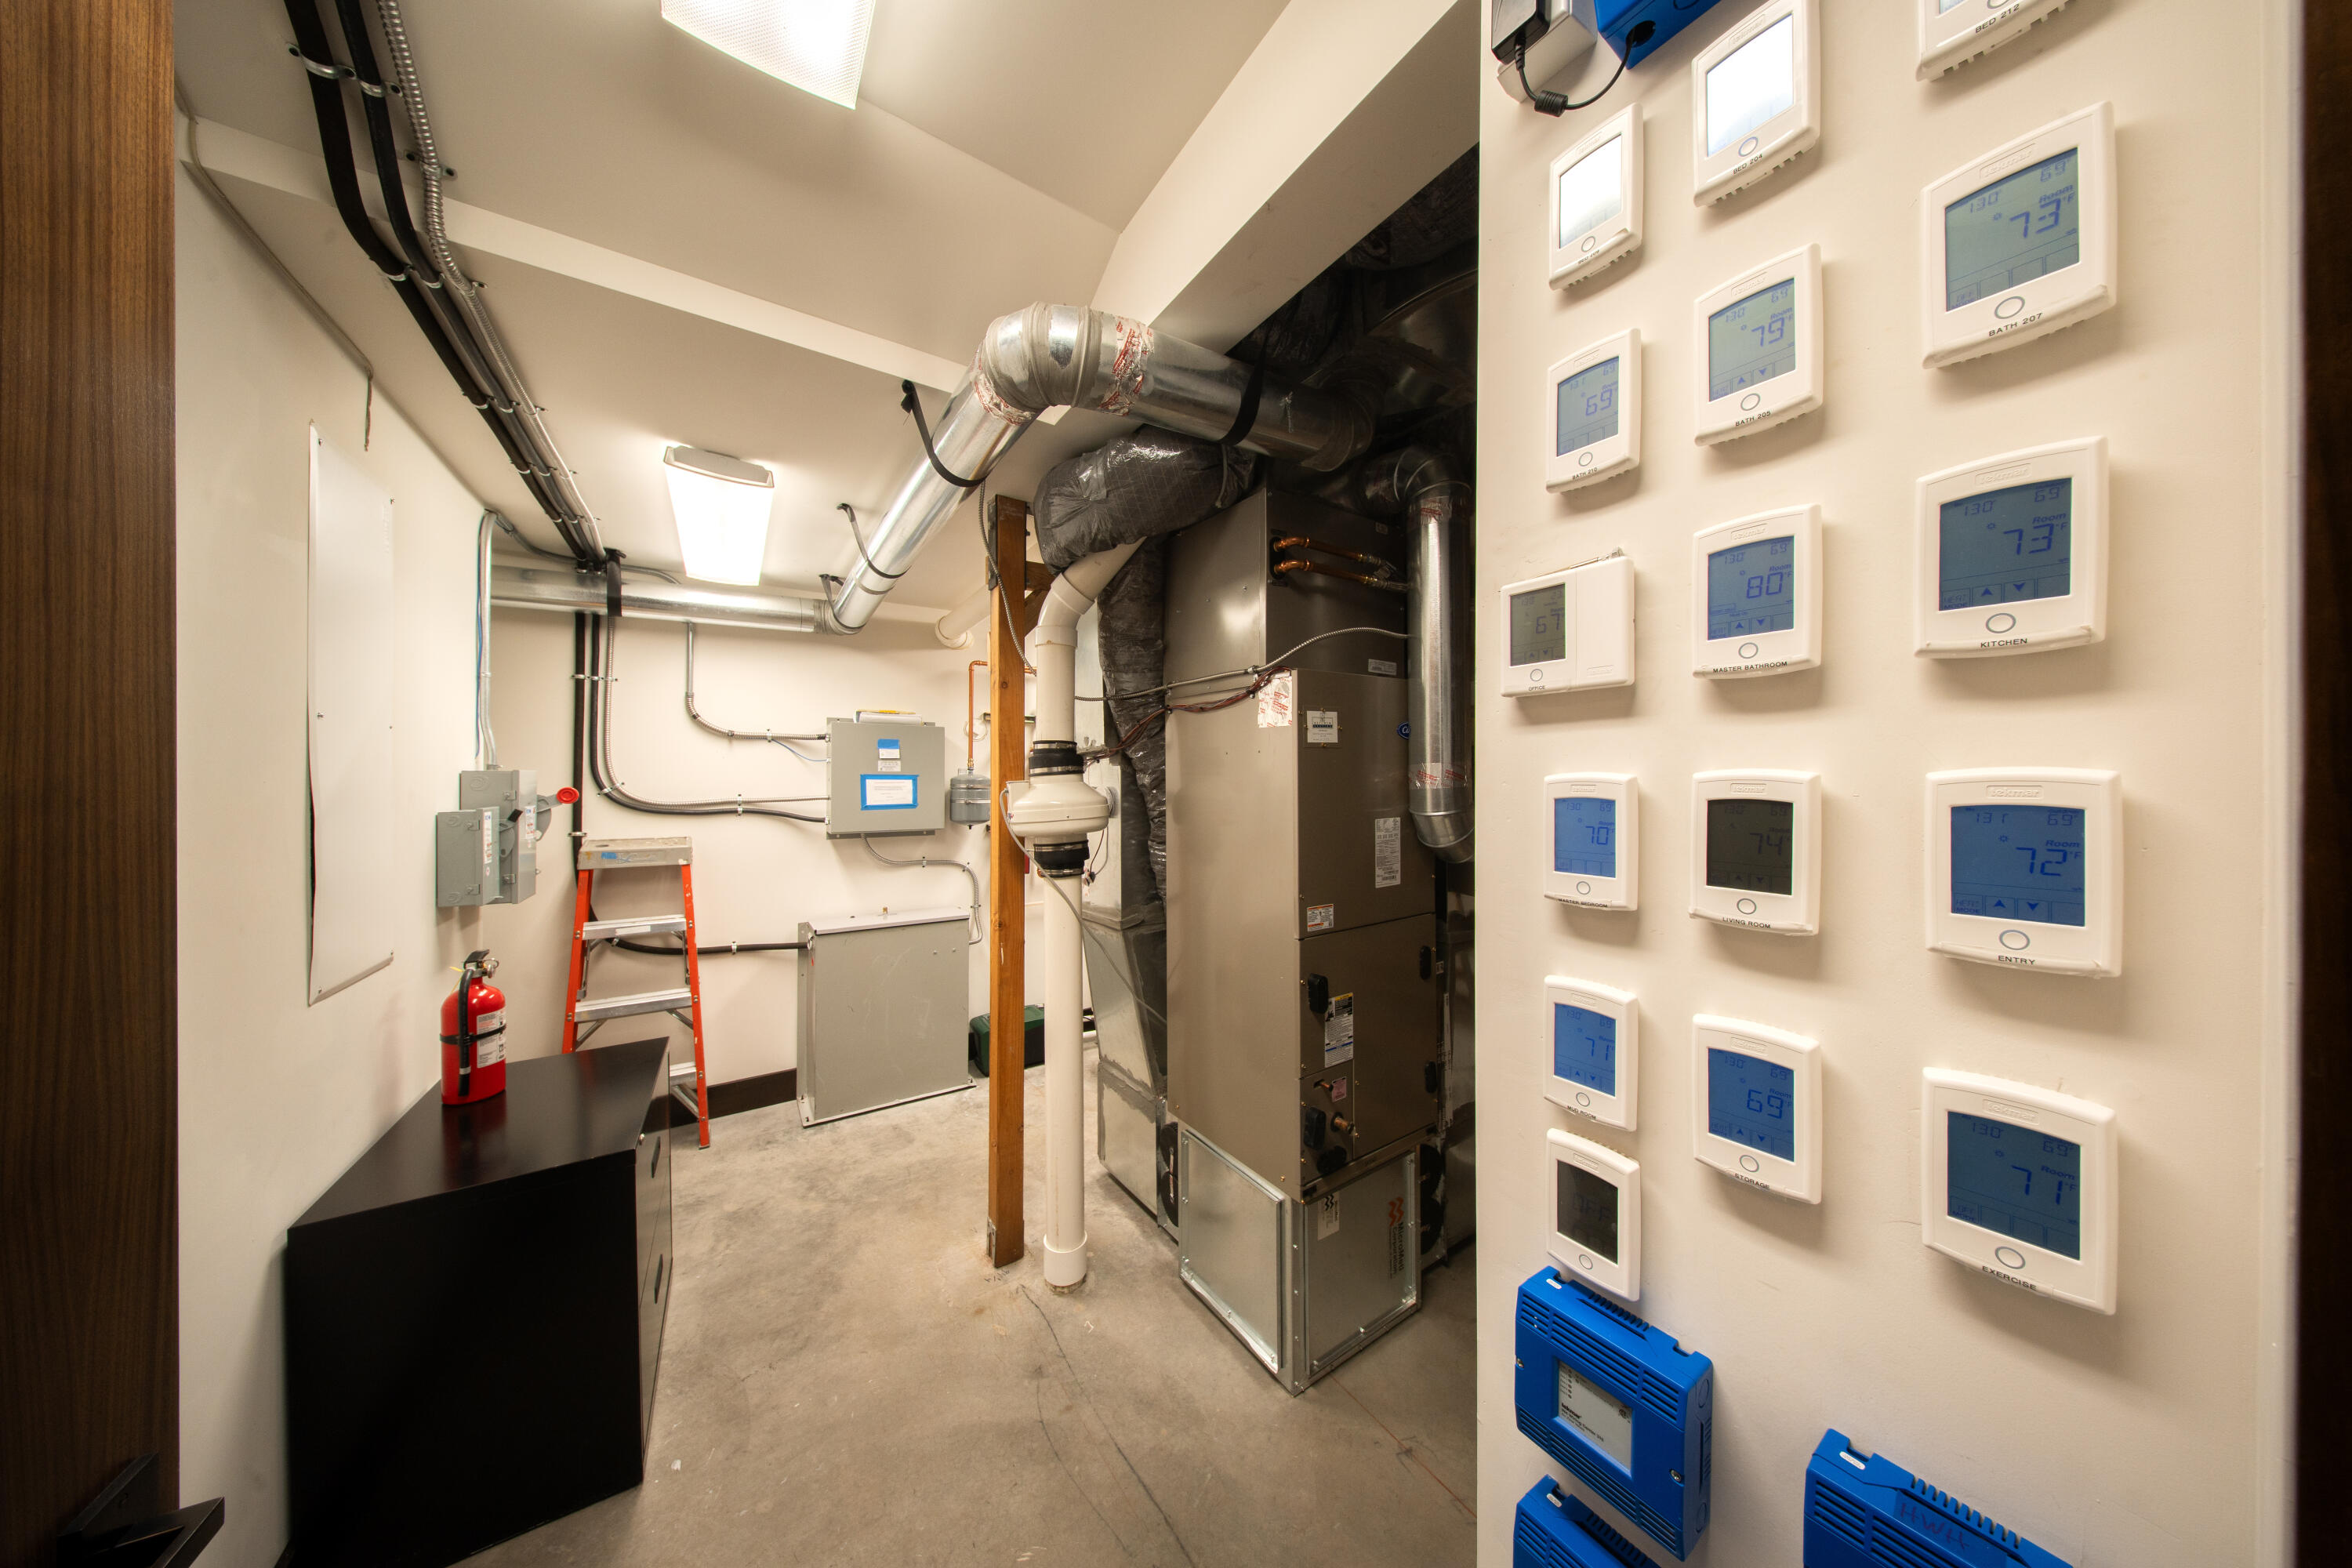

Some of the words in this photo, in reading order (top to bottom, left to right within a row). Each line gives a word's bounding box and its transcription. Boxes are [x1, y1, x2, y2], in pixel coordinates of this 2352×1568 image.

[1975, 17, 1996, 34] BED
[2001, 4, 2020, 19] 212
[1733, 162, 1748, 175] BED
[2039, 184, 2074, 204] Room
[2009, 198, 2061, 239] 73
[1751, 317, 1785, 347] 79
[1988, 321, 2018, 337] BATH
[2022, 312, 2043, 326] 207
[1585, 387, 1613, 416] 69
[1735, 416, 1755, 427] BATH
[1757, 410, 1771, 419] 205
[1572, 471, 1586, 481] BATH
[2032, 513, 2067, 524] Room
[2003, 523, 2055, 555] 73
[1769, 564, 1792, 572] Room
[1746, 572, 1784, 599] 80
[1535, 613, 1561, 634] 67
[1980, 638, 2028, 648] KITCHEN
[1744, 662, 1788, 671] BATHROOM
[1991, 787, 2040, 798] tekmar
[1585, 826, 1610, 845] 70
[1749, 832, 1784, 856] 74
[2045, 840, 2081, 848] Room
[2016, 847, 2068, 877] 72
[1722, 916, 1746, 925] LIVING
[1748, 920, 1771, 929] ROOM
[1998, 955, 2036, 965] ENTRY
[1584, 1036, 1610, 1061] 71
[1769, 1087, 1792, 1098] Room
[1747, 1089, 1784, 1119] 69
[1580, 1110, 1597, 1120] ROOM
[1734, 1172, 1770, 1190] STORAGE
[2041, 1165, 2075, 1181] Room
[2011, 1165, 2063, 1205] 71
[1982, 1265, 2038, 1291] EXERCISE
